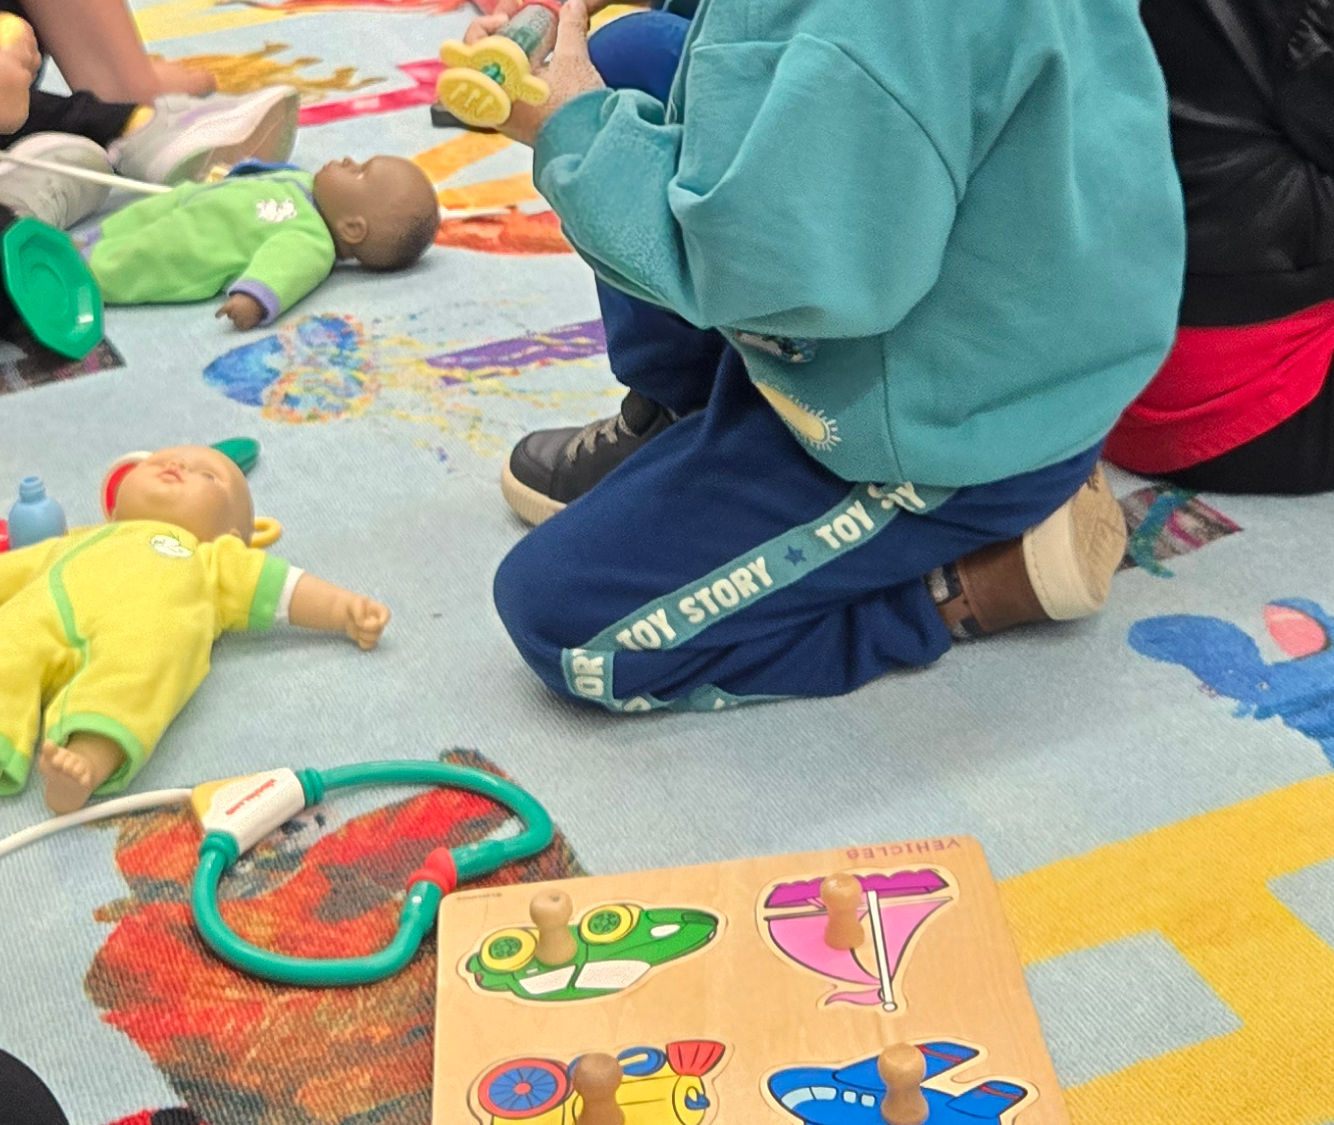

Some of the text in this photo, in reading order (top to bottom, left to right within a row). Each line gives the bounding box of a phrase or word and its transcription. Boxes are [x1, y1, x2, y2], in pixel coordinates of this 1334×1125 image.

[814, 500, 875, 550] TOY
[615, 556, 774, 651] TOY STORY
[845, 838, 961, 860] VEHICLES
